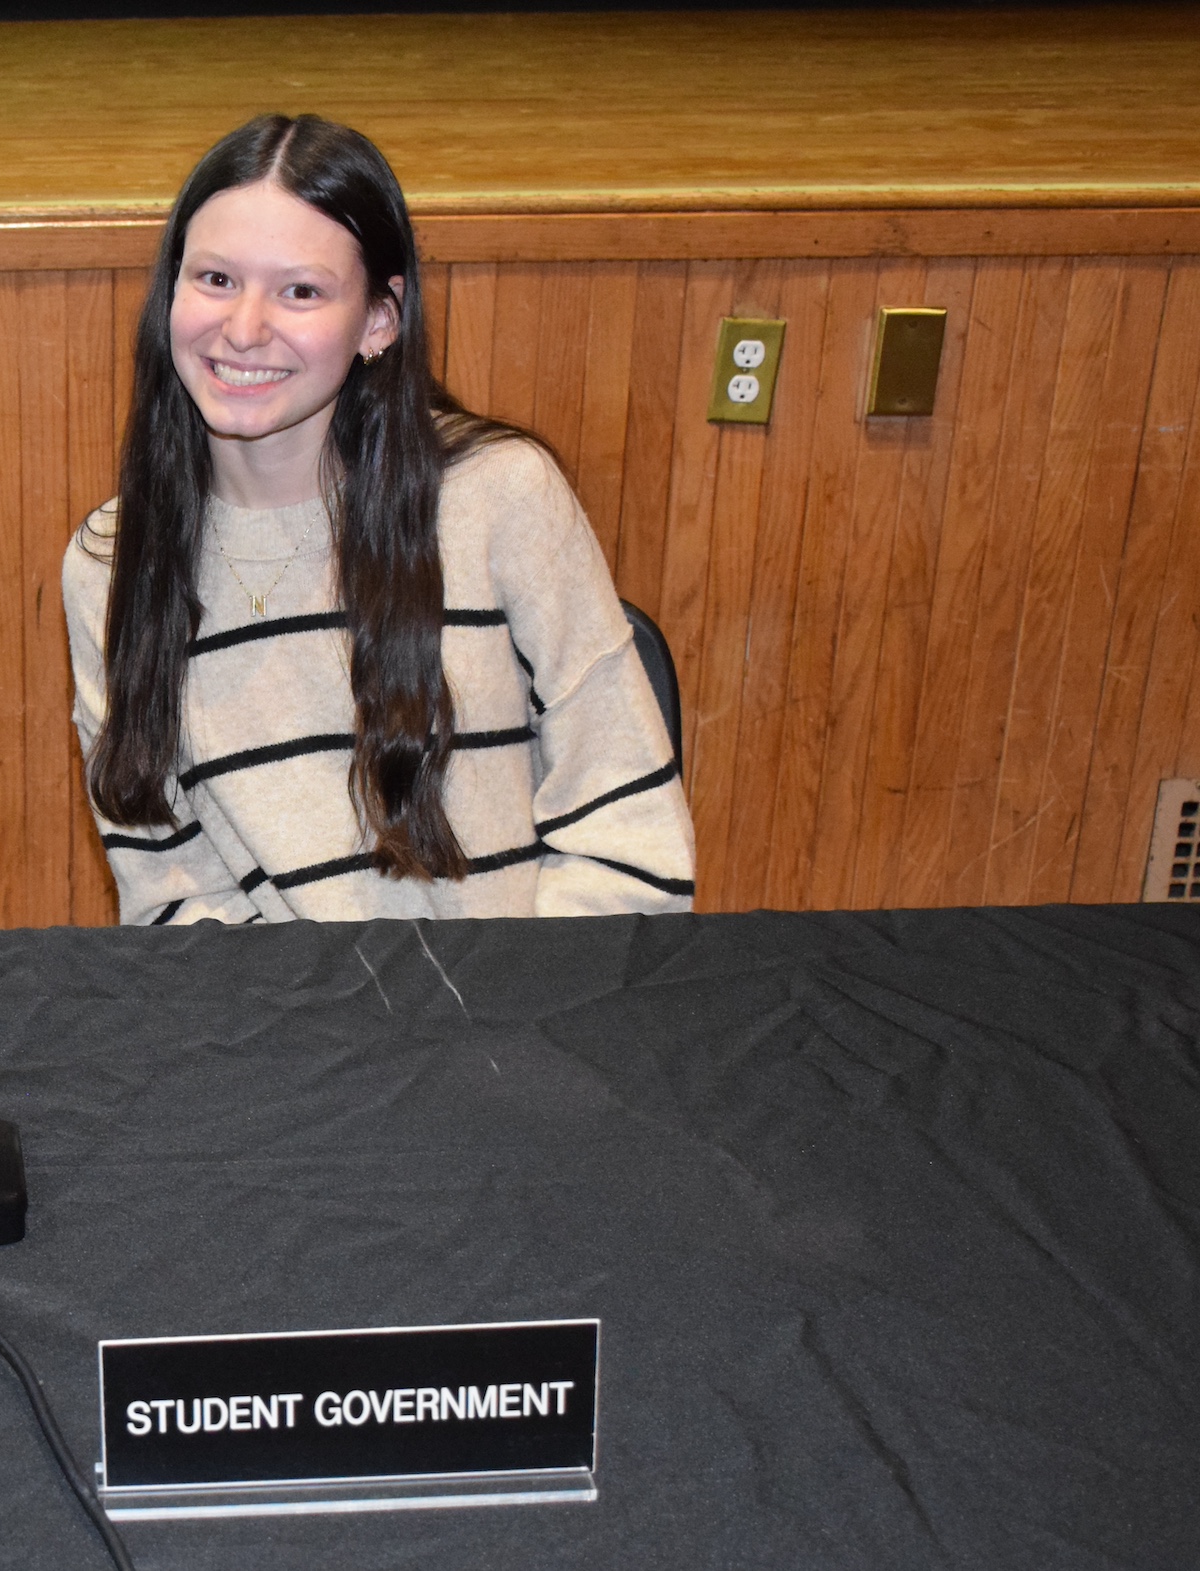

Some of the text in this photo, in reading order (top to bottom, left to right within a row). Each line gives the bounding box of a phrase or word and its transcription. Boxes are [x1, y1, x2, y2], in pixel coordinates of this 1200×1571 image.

[250, 595, 267, 617] N
[126, 1380, 575, 1436] STUDENT GOVERNMENT
